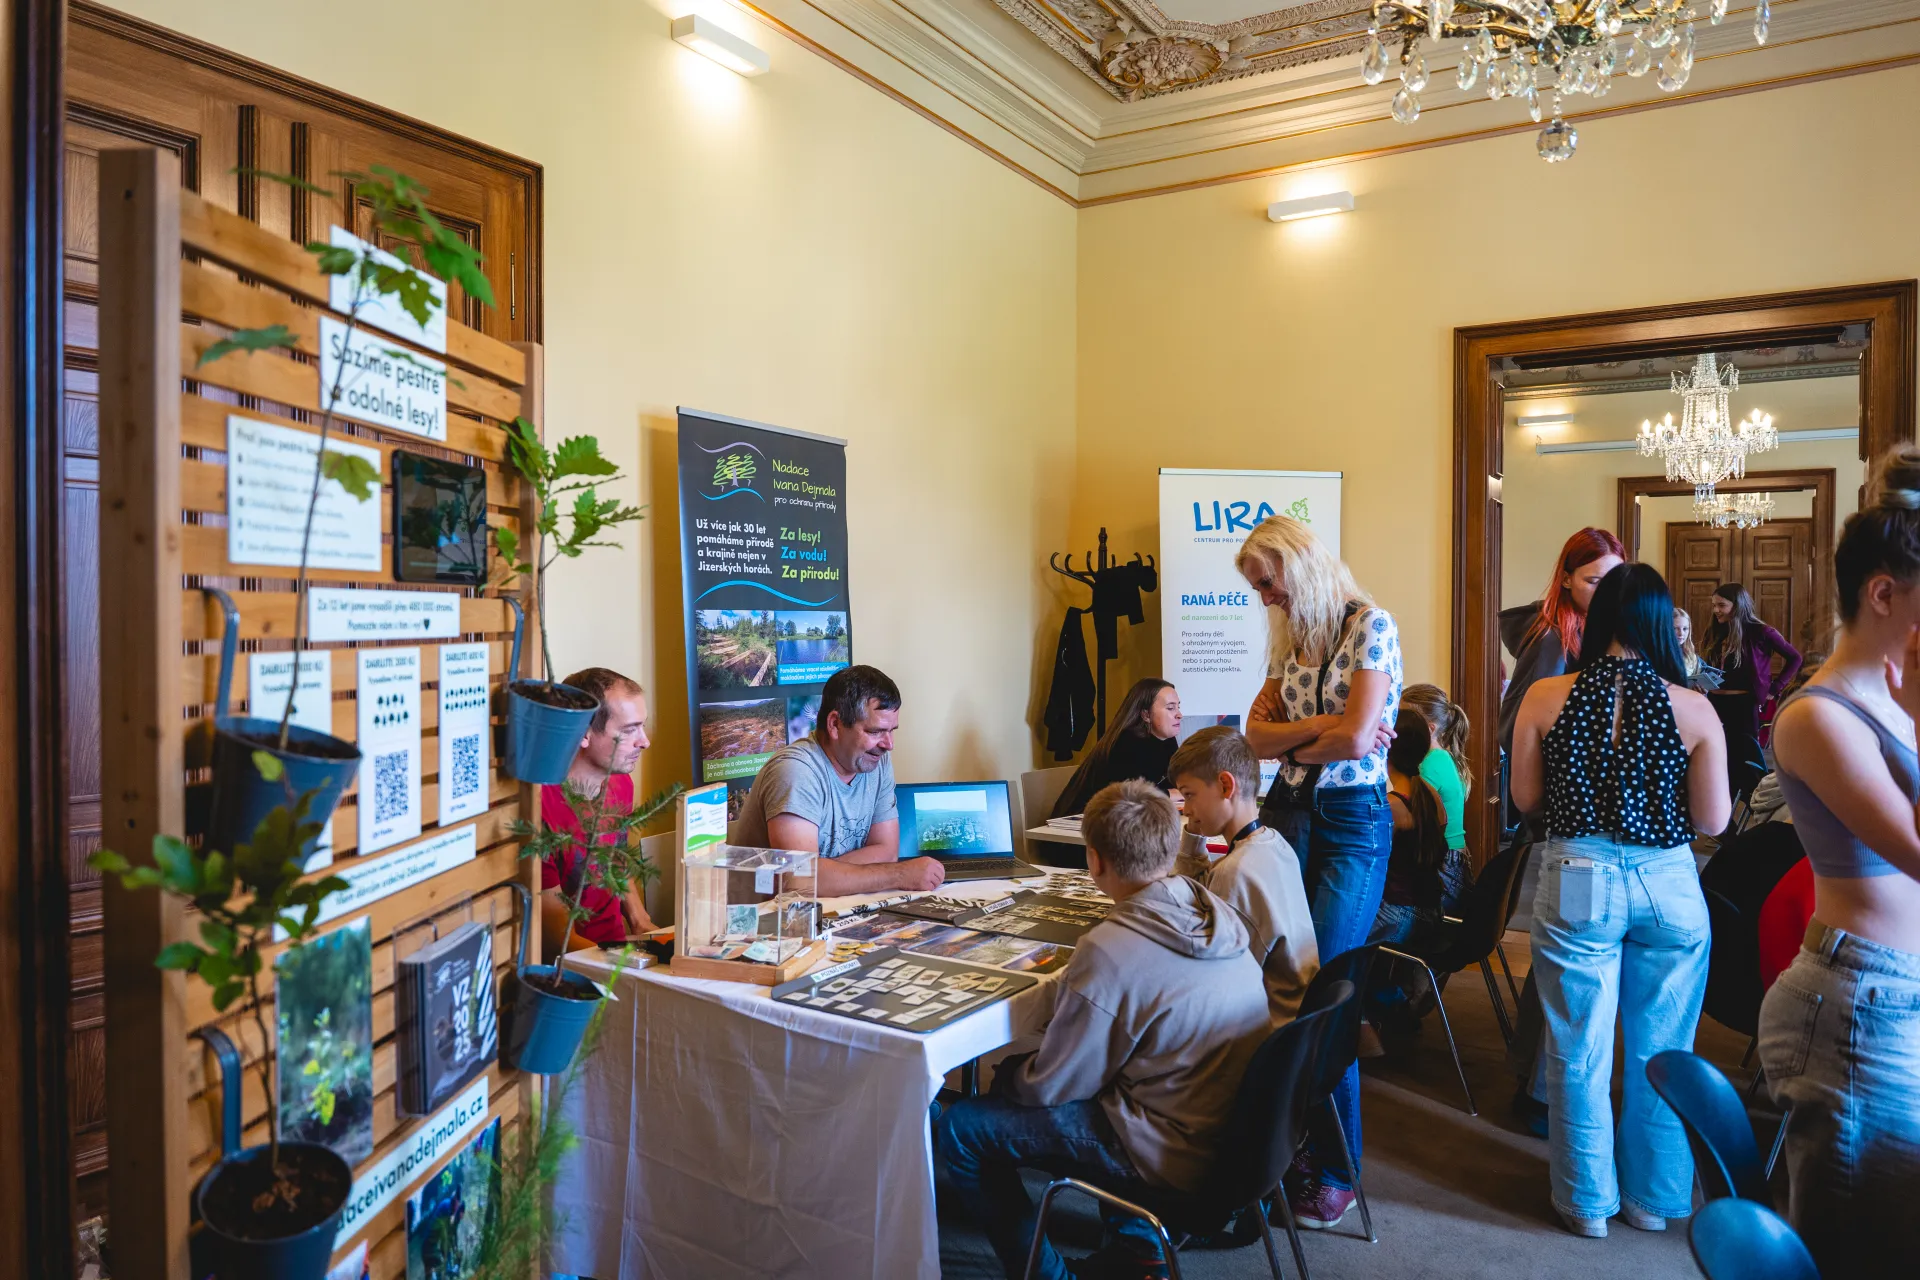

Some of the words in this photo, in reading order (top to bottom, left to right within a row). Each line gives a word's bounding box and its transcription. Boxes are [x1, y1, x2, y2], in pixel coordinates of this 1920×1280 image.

[331, 334, 392, 378] Sazíme
[397, 365, 440, 394] pestré
[348, 383, 404, 420] odolné
[407, 397, 439, 436] lesy!
[772, 459, 809, 477] Nadace
[773, 479, 800, 493] Ivana
[802, 481, 837, 500] Dejmala
[774, 497, 787, 506] pro
[789, 497, 814, 508] ochranu
[815, 500, 837, 513] přírody
[1193, 500, 1276, 534] LIRA
[696, 518, 708, 529] Už
[710, 521, 727, 531] více
[728, 522, 742, 534] jak
[743, 523, 755, 534] 30
[756, 523, 767, 534] let
[697, 535, 744, 547] pomáháme
[746, 538, 775, 550] přírodě
[780, 527, 796, 541] Za
[798, 529, 821, 544] lesy!
[697, 549, 704, 557] a
[706, 548, 735, 562] krajině
[738, 551, 759, 562] nejen
[761, 553, 767, 561] v
[780, 547, 797, 560] Za
[799, 549, 827, 562] vodu!
[698, 561, 742, 576] Jizerských
[743, 563, 773, 575] horách.
[781, 566, 798, 579] Za
[800, 567, 839, 582] přírodu!
[1181, 591, 1216, 606] RANÁ
[1218, 591, 1249, 606] PÉČE
[1181, 613, 1190, 621] od
[1191, 613, 1218, 621] narození
[1219, 613, 1228, 621] do
[1229, 613, 1233, 621] 7
[1234, 613, 1243, 621] let
[1193, 630, 1212, 639] rodiny
[1213, 630, 1224, 638] dětí
[1186, 639, 1219, 648] ohroženým
[1220, 639, 1246, 648] vývojem,
[1216, 648, 1249, 657] postižením
[1203, 657, 1232, 666] poruchou
[1218, 666, 1242, 674] spektra.
[707, 771, 713, 779] je
[452, 976, 471, 1007] VZ
[453, 1005, 470, 1034] 20
[454, 1029, 472, 1062] 25
[336, 1095, 484, 1229] daceivanadejmala.cz
